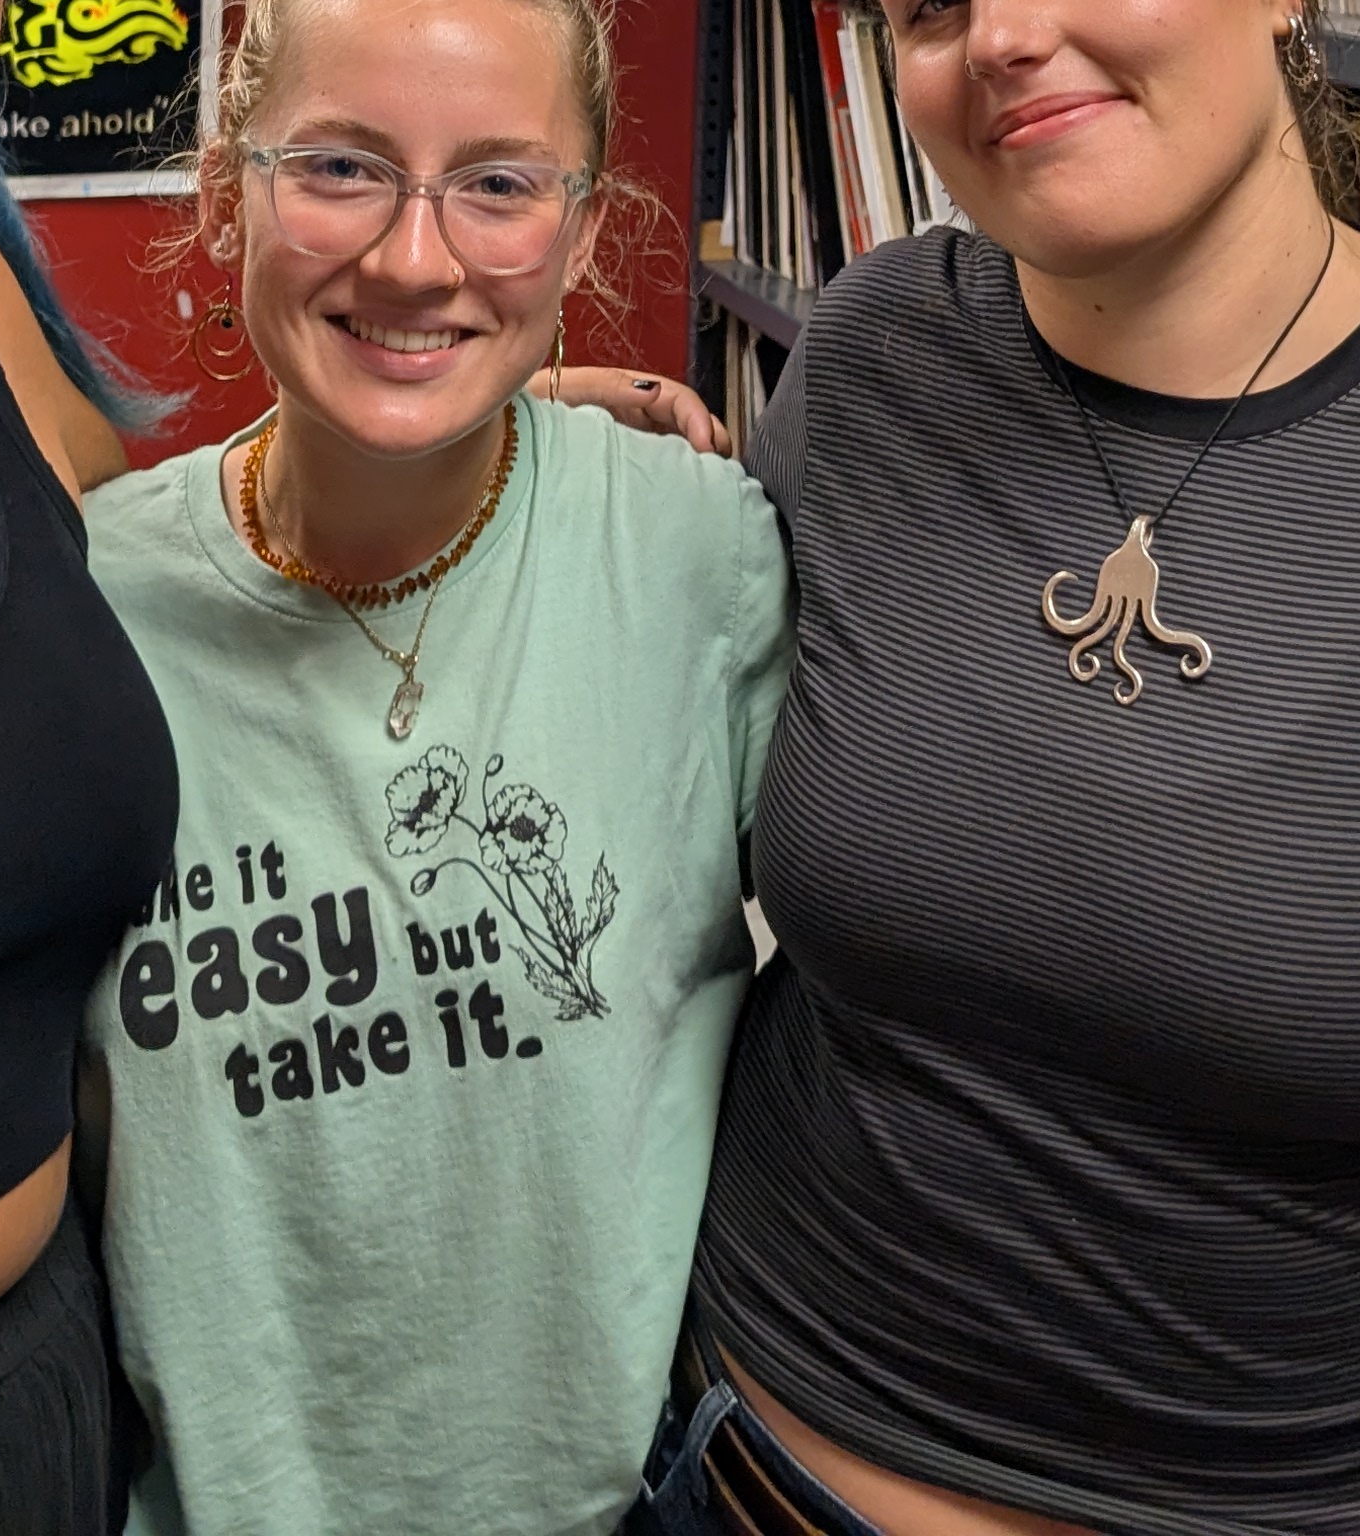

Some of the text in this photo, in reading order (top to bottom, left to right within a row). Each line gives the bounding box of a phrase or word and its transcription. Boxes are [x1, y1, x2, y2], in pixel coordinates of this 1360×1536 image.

[160, 840, 286, 923] ke it
[119, 886, 501, 1051] easy but
[225, 980, 543, 1117] take it.
